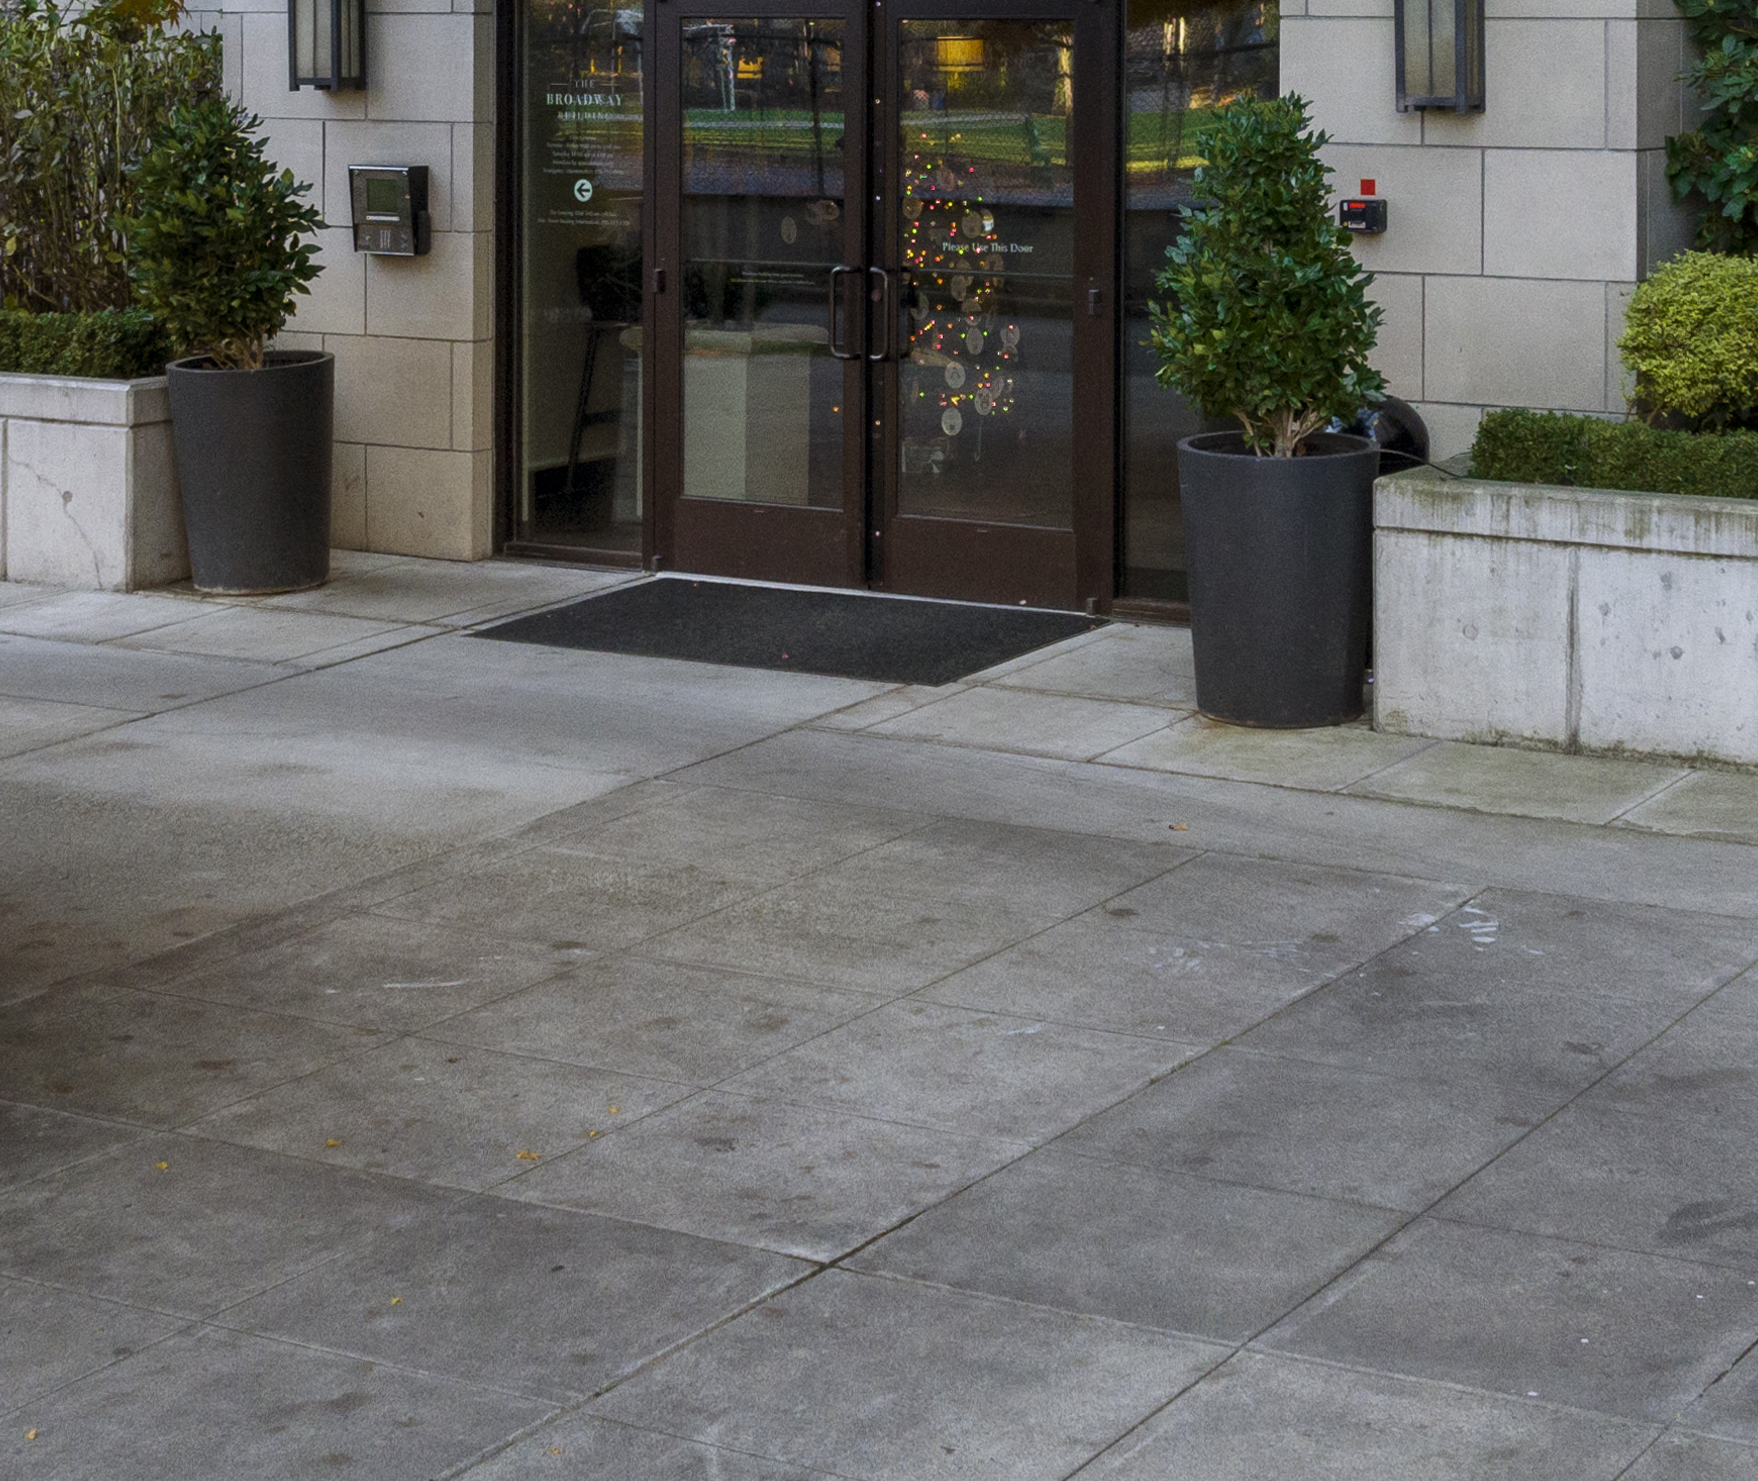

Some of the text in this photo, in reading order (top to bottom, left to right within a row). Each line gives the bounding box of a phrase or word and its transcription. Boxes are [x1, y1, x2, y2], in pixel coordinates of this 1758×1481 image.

[574, 79, 596, 89] THE
[546, 93, 623, 106] BROADWAY
[942, 242, 1034, 253] Please Use This Door
